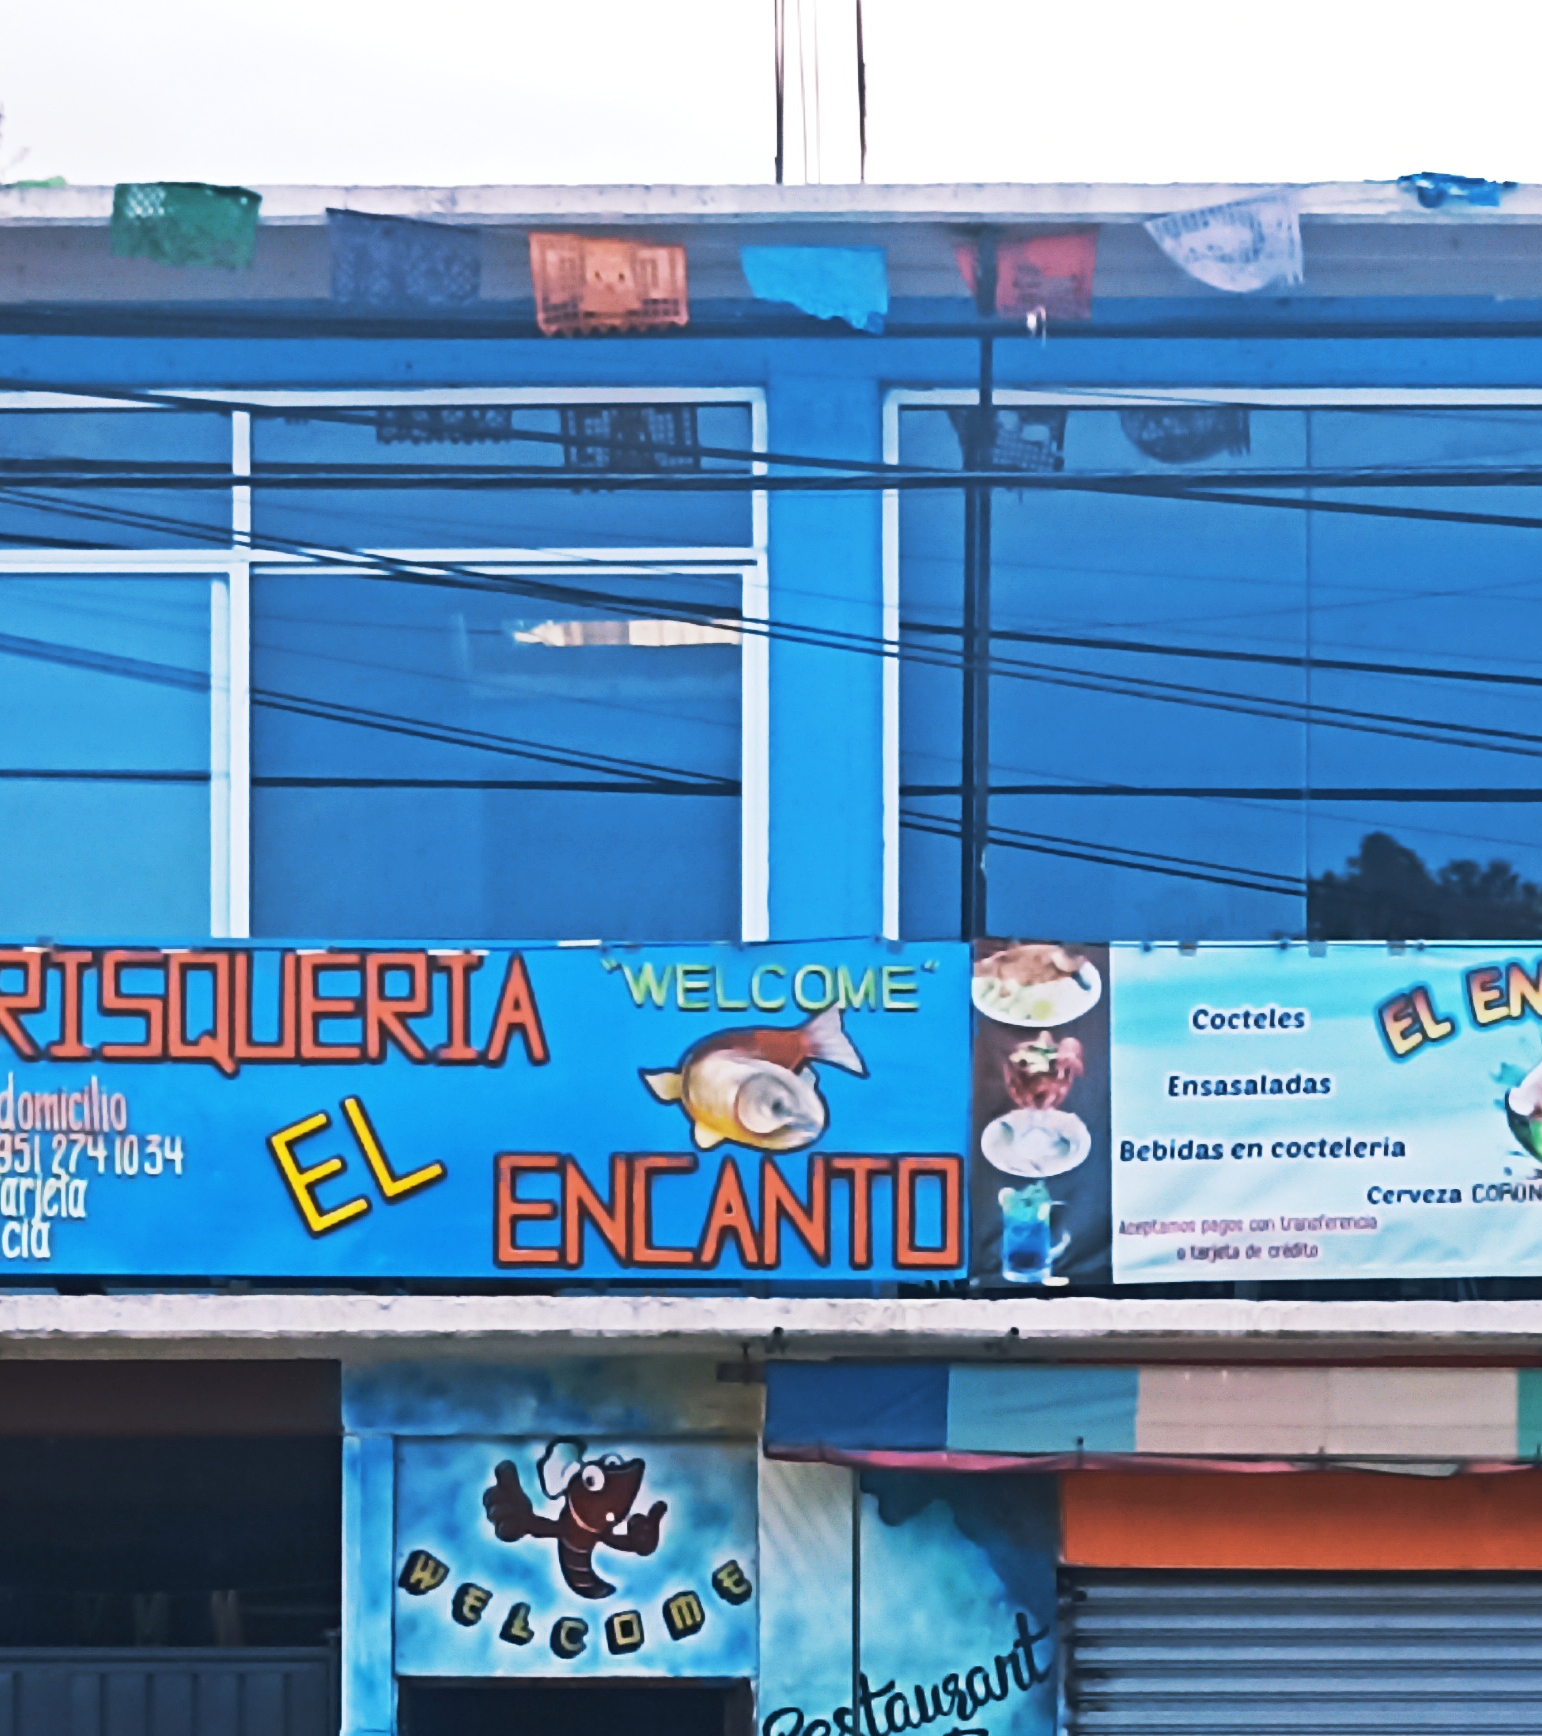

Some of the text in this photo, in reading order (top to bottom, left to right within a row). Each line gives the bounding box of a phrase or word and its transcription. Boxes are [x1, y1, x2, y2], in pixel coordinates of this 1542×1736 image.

[1192, 1007, 1306, 1031] Cocteles
[1378, 985, 1456, 1059] EL
[1168, 1073, 1332, 1097] Ensasaladas
[51, 1133, 108, 1175] 274
[267, 1095, 448, 1240] EL
[1119, 1139, 1224, 1162] Bebidas
[1231, 1142, 1263, 1160] en
[493, 1153, 965, 1271] ENCANTO
[1367, 1184, 1462, 1205] Cerveza
[398, 1549, 752, 1659] WELCOME
